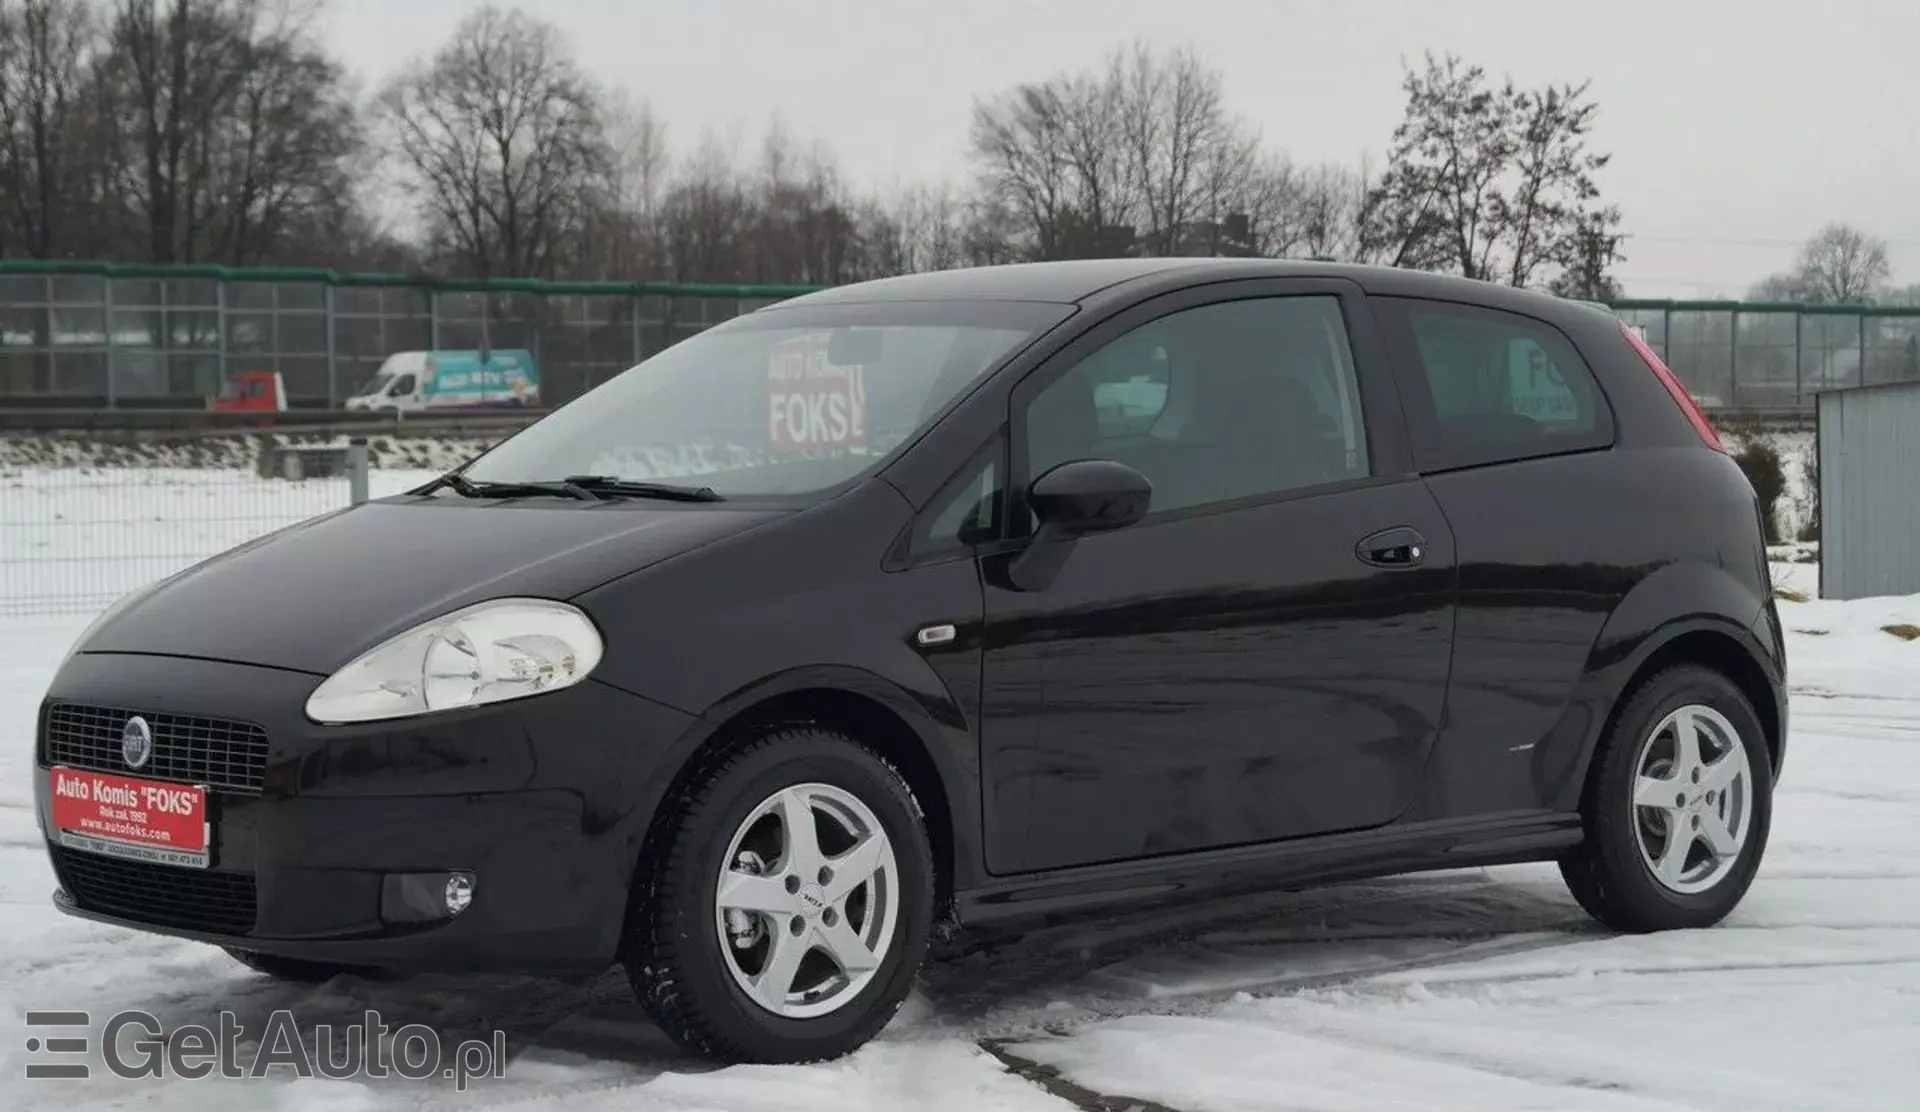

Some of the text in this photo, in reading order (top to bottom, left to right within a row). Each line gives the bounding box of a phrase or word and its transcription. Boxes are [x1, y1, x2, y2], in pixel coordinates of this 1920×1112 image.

[770, 393, 848, 442] FOKS
[56, 774, 198, 815] Auto Komis "FOKS"
[80, 817, 171, 841] www.autofoks.com
[99, 805, 115, 818] Rok
[130, 812, 148, 824] 1992
